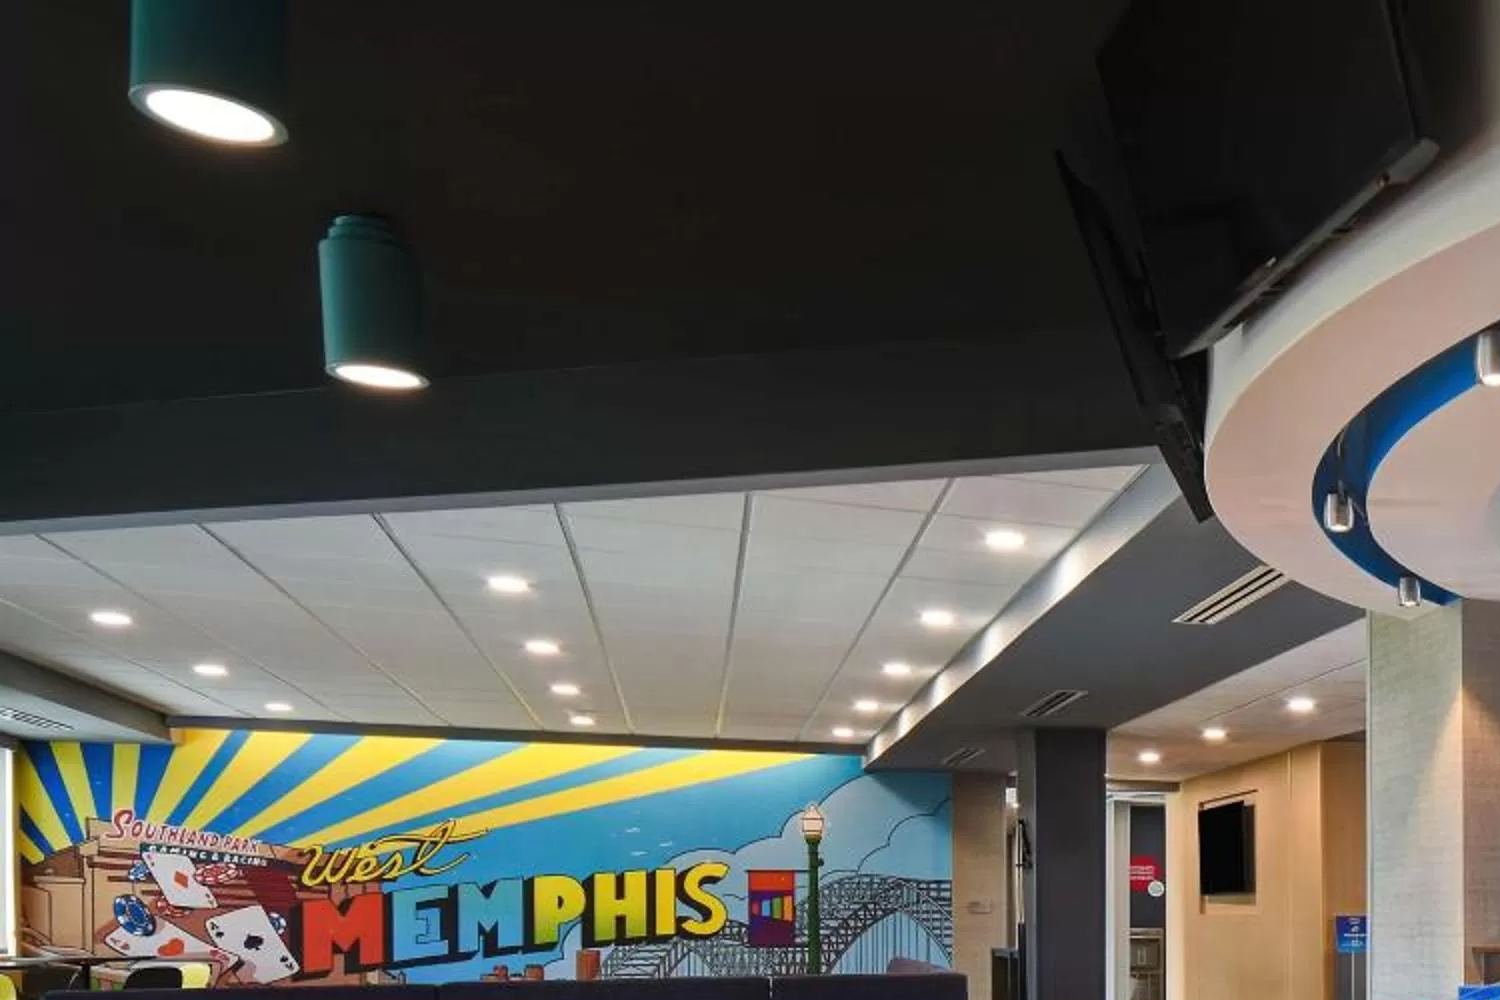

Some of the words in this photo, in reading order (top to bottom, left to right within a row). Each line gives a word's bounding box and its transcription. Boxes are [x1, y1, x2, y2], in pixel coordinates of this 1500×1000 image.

[106, 808, 218, 848] SOUTHLAND
[221, 836, 258, 852] PARK
[302, 818, 491, 886] West
[223, 852, 268, 867] RACING
[302, 860, 730, 972] MEMPHIS
